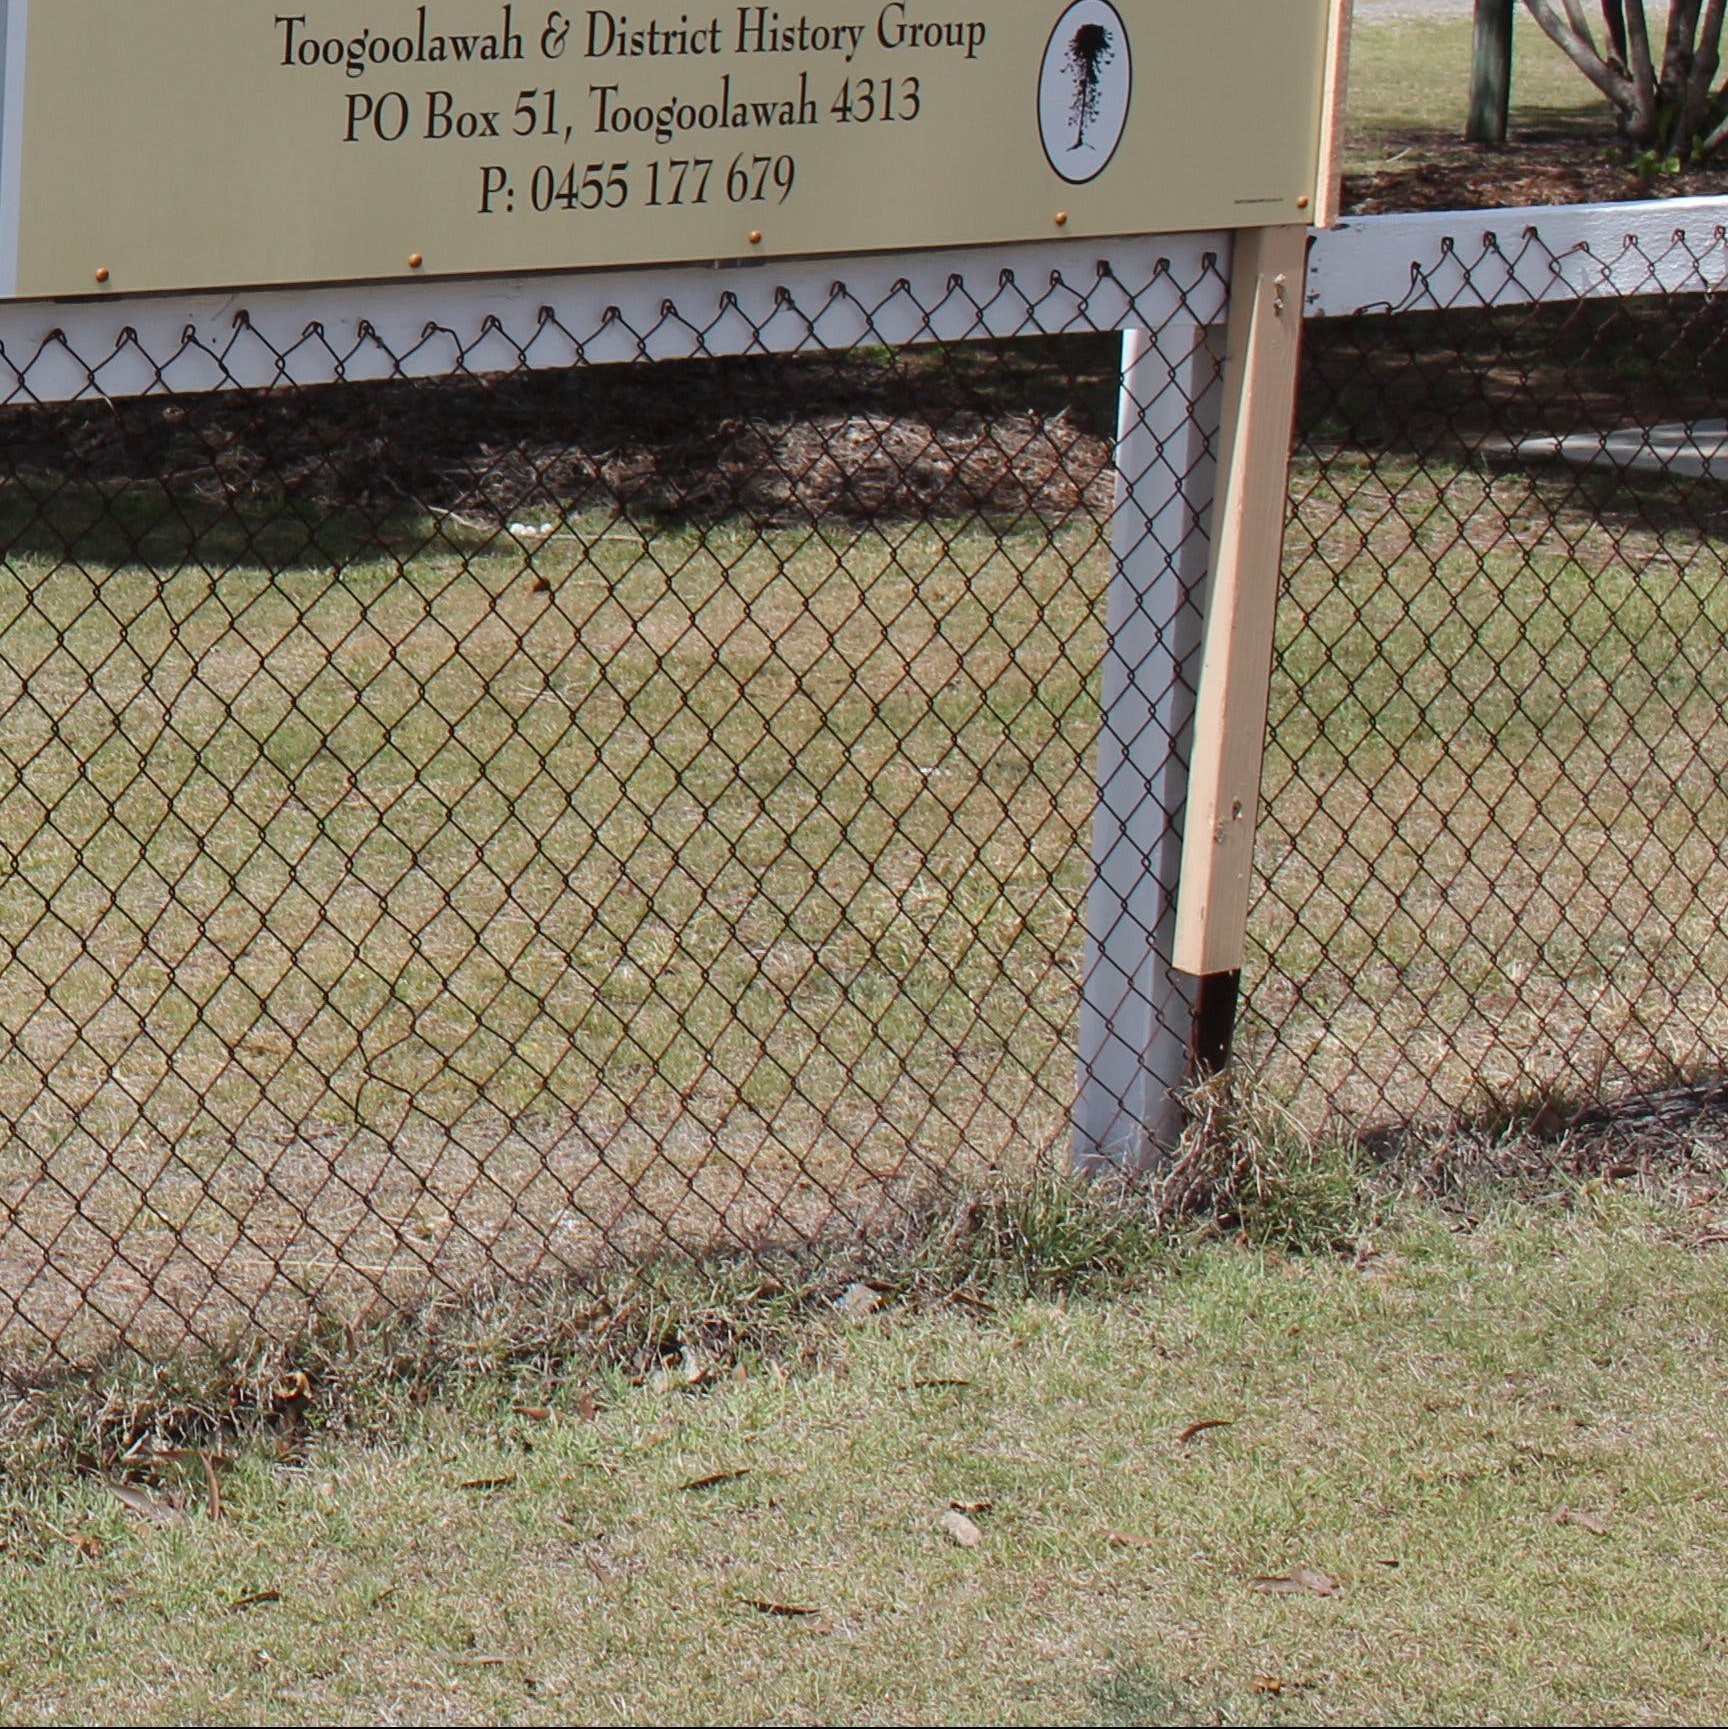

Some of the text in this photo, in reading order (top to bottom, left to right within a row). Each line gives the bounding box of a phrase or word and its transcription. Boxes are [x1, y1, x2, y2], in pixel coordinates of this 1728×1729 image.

[274, 0, 987, 79] Toogoolawah & District History Group
[341, 72, 922, 144] PO Box 51, Toogoolawah 4313
[476, 151, 797, 215] P: 0455 177 679
